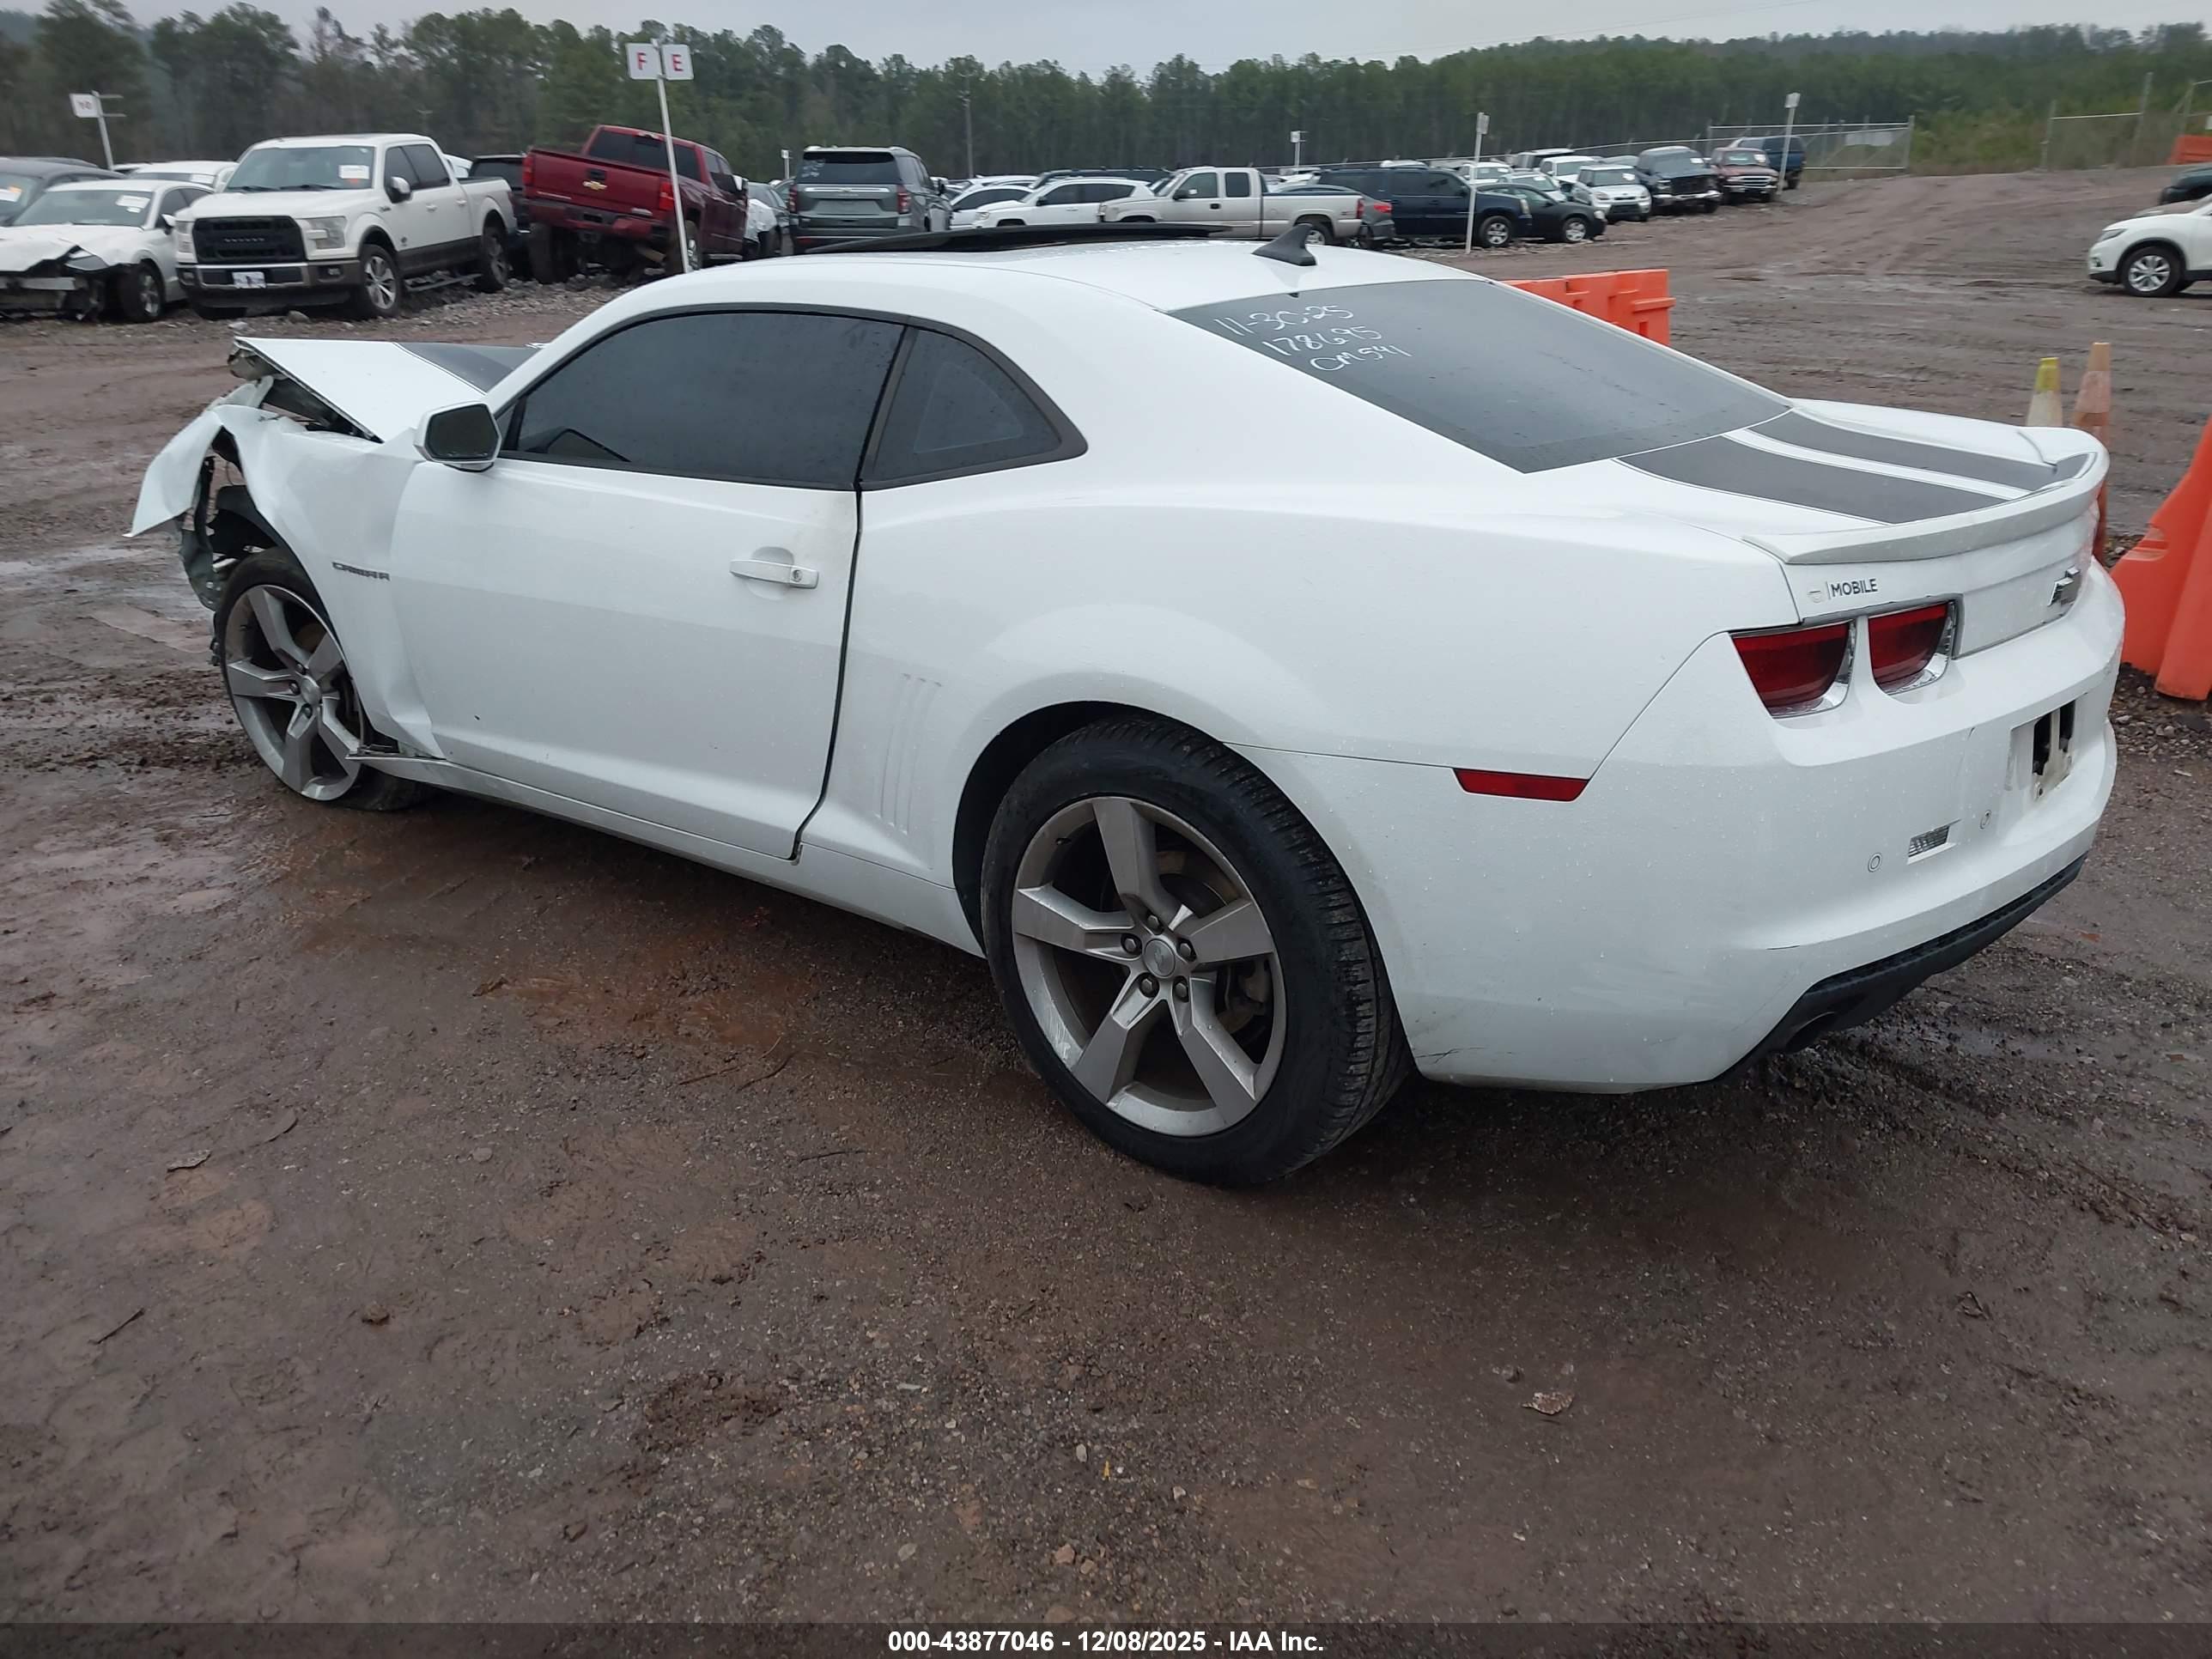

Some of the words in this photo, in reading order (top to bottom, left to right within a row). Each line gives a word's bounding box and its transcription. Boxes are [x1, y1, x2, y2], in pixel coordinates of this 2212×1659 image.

[635, 52, 647, 70] F
[672, 53, 684, 72] E
[1830, 578, 1879, 598] MOBILE
